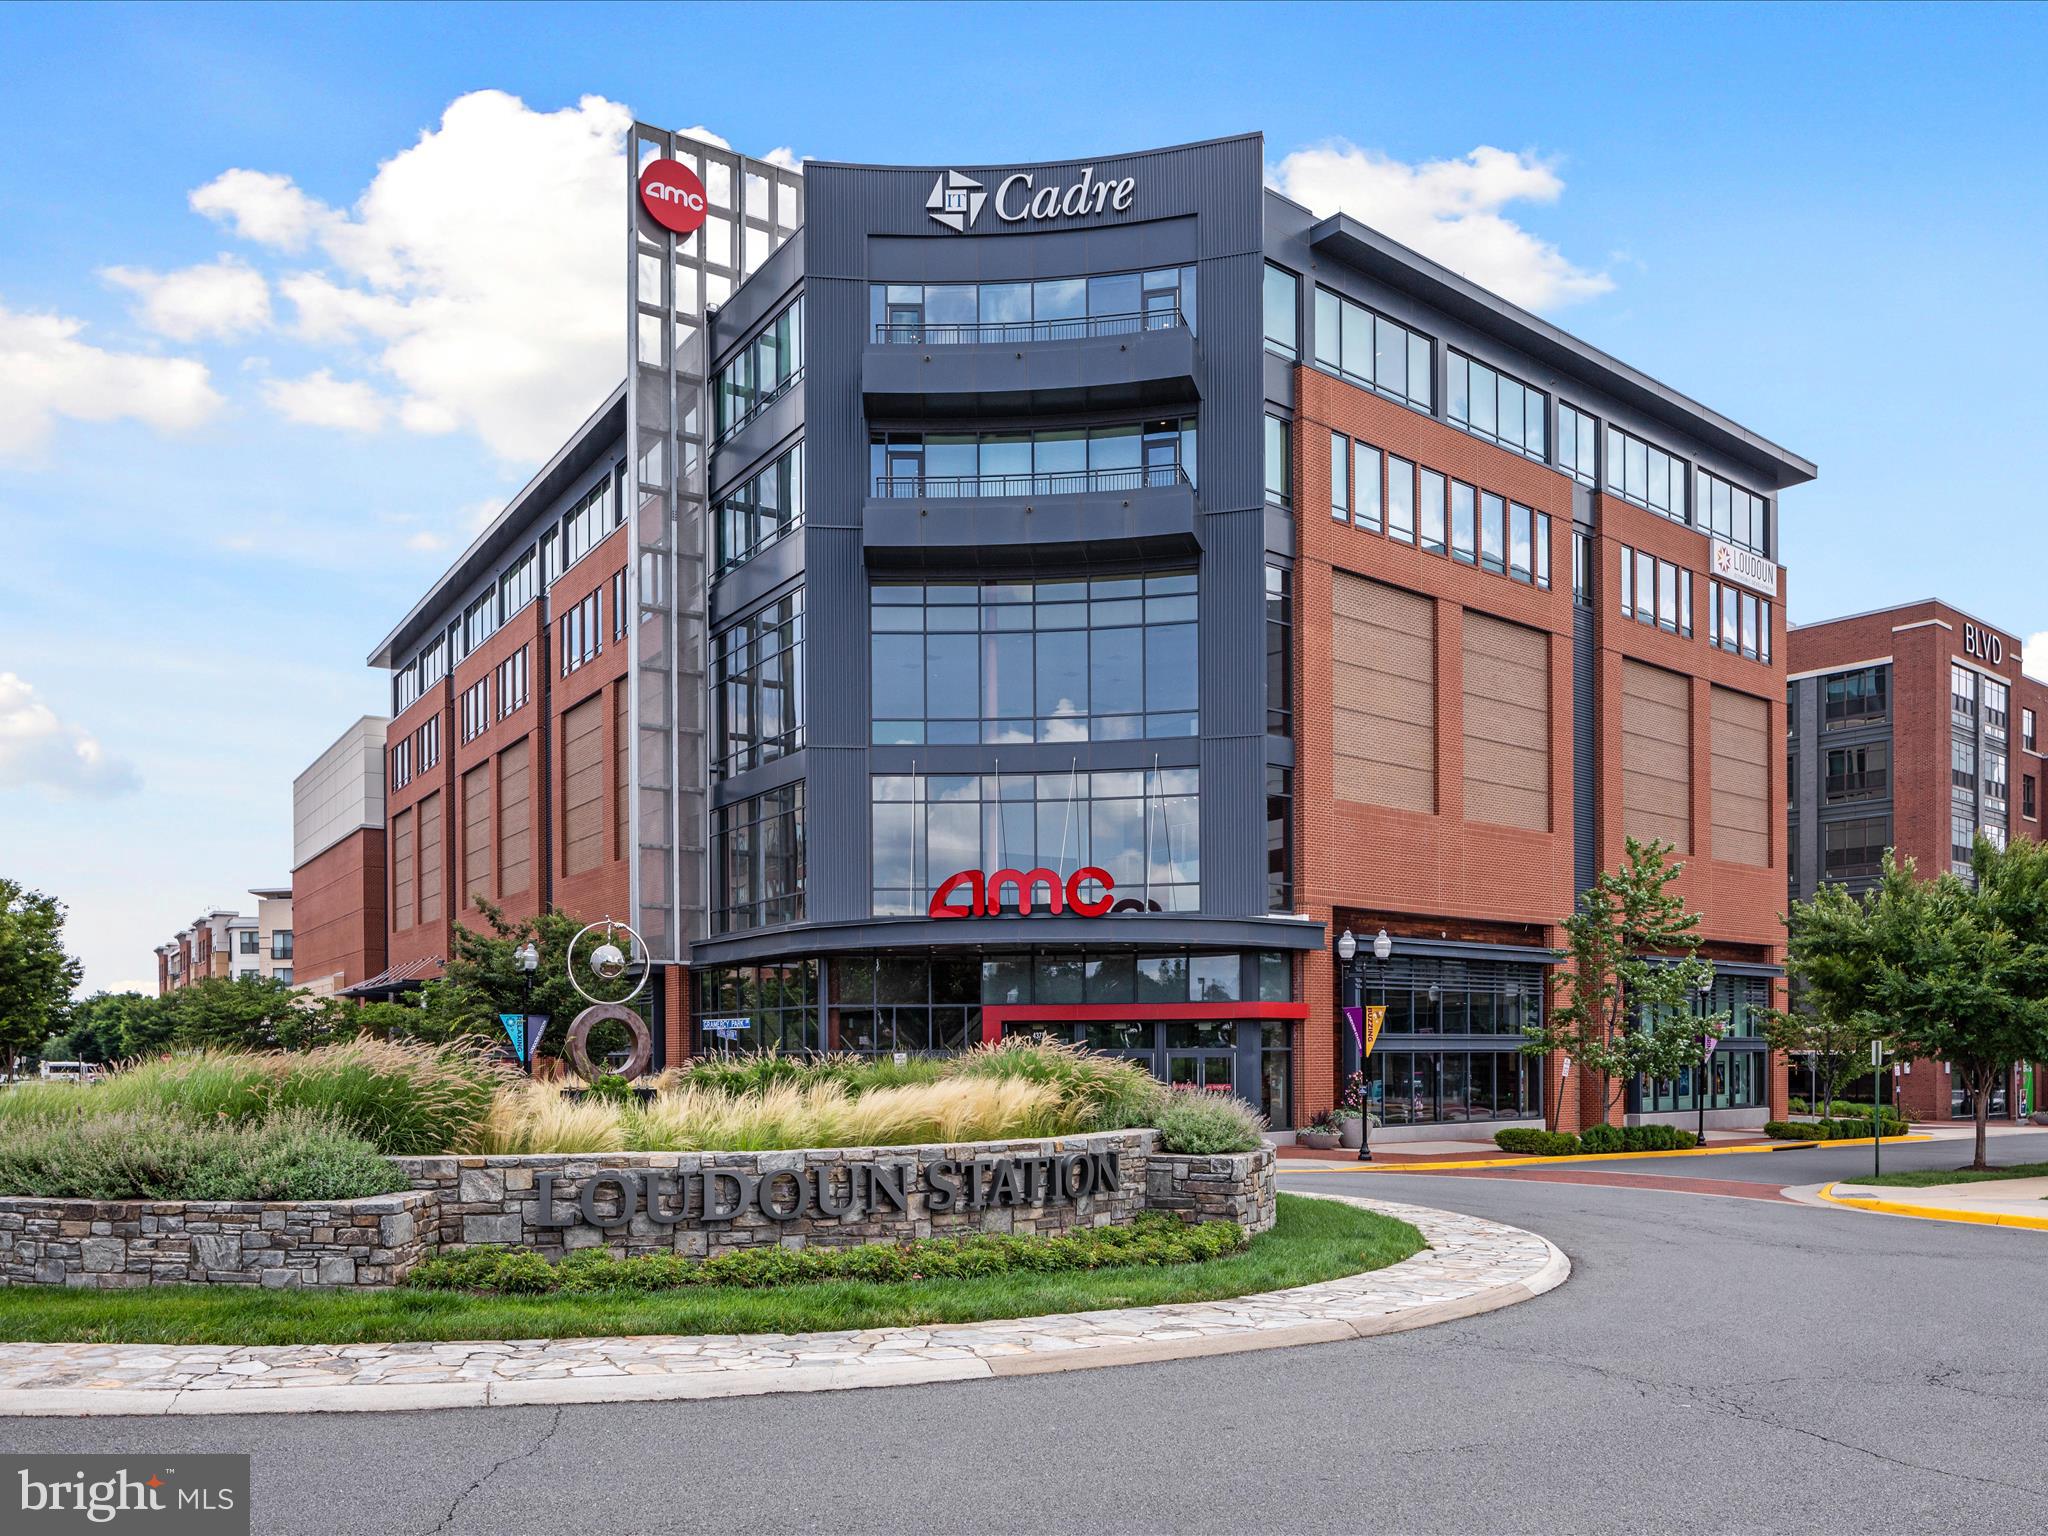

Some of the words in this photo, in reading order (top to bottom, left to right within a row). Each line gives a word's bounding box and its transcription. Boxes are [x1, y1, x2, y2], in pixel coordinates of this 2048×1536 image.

[645, 182, 704, 212] amc
[947, 193, 966, 209] IT
[995, 167, 1136, 221] Cadre
[1733, 550, 1774, 585] LOUDOUN
[1965, 622, 2002, 665] BLVD
[928, 866, 1115, 919] amc
[703, 1020, 730, 1029] GRAMERCY
[731, 1019, 744, 1028] PARK
[535, 1163, 909, 1228] LOUDOUN
[924, 1151, 1121, 1211] STATION
